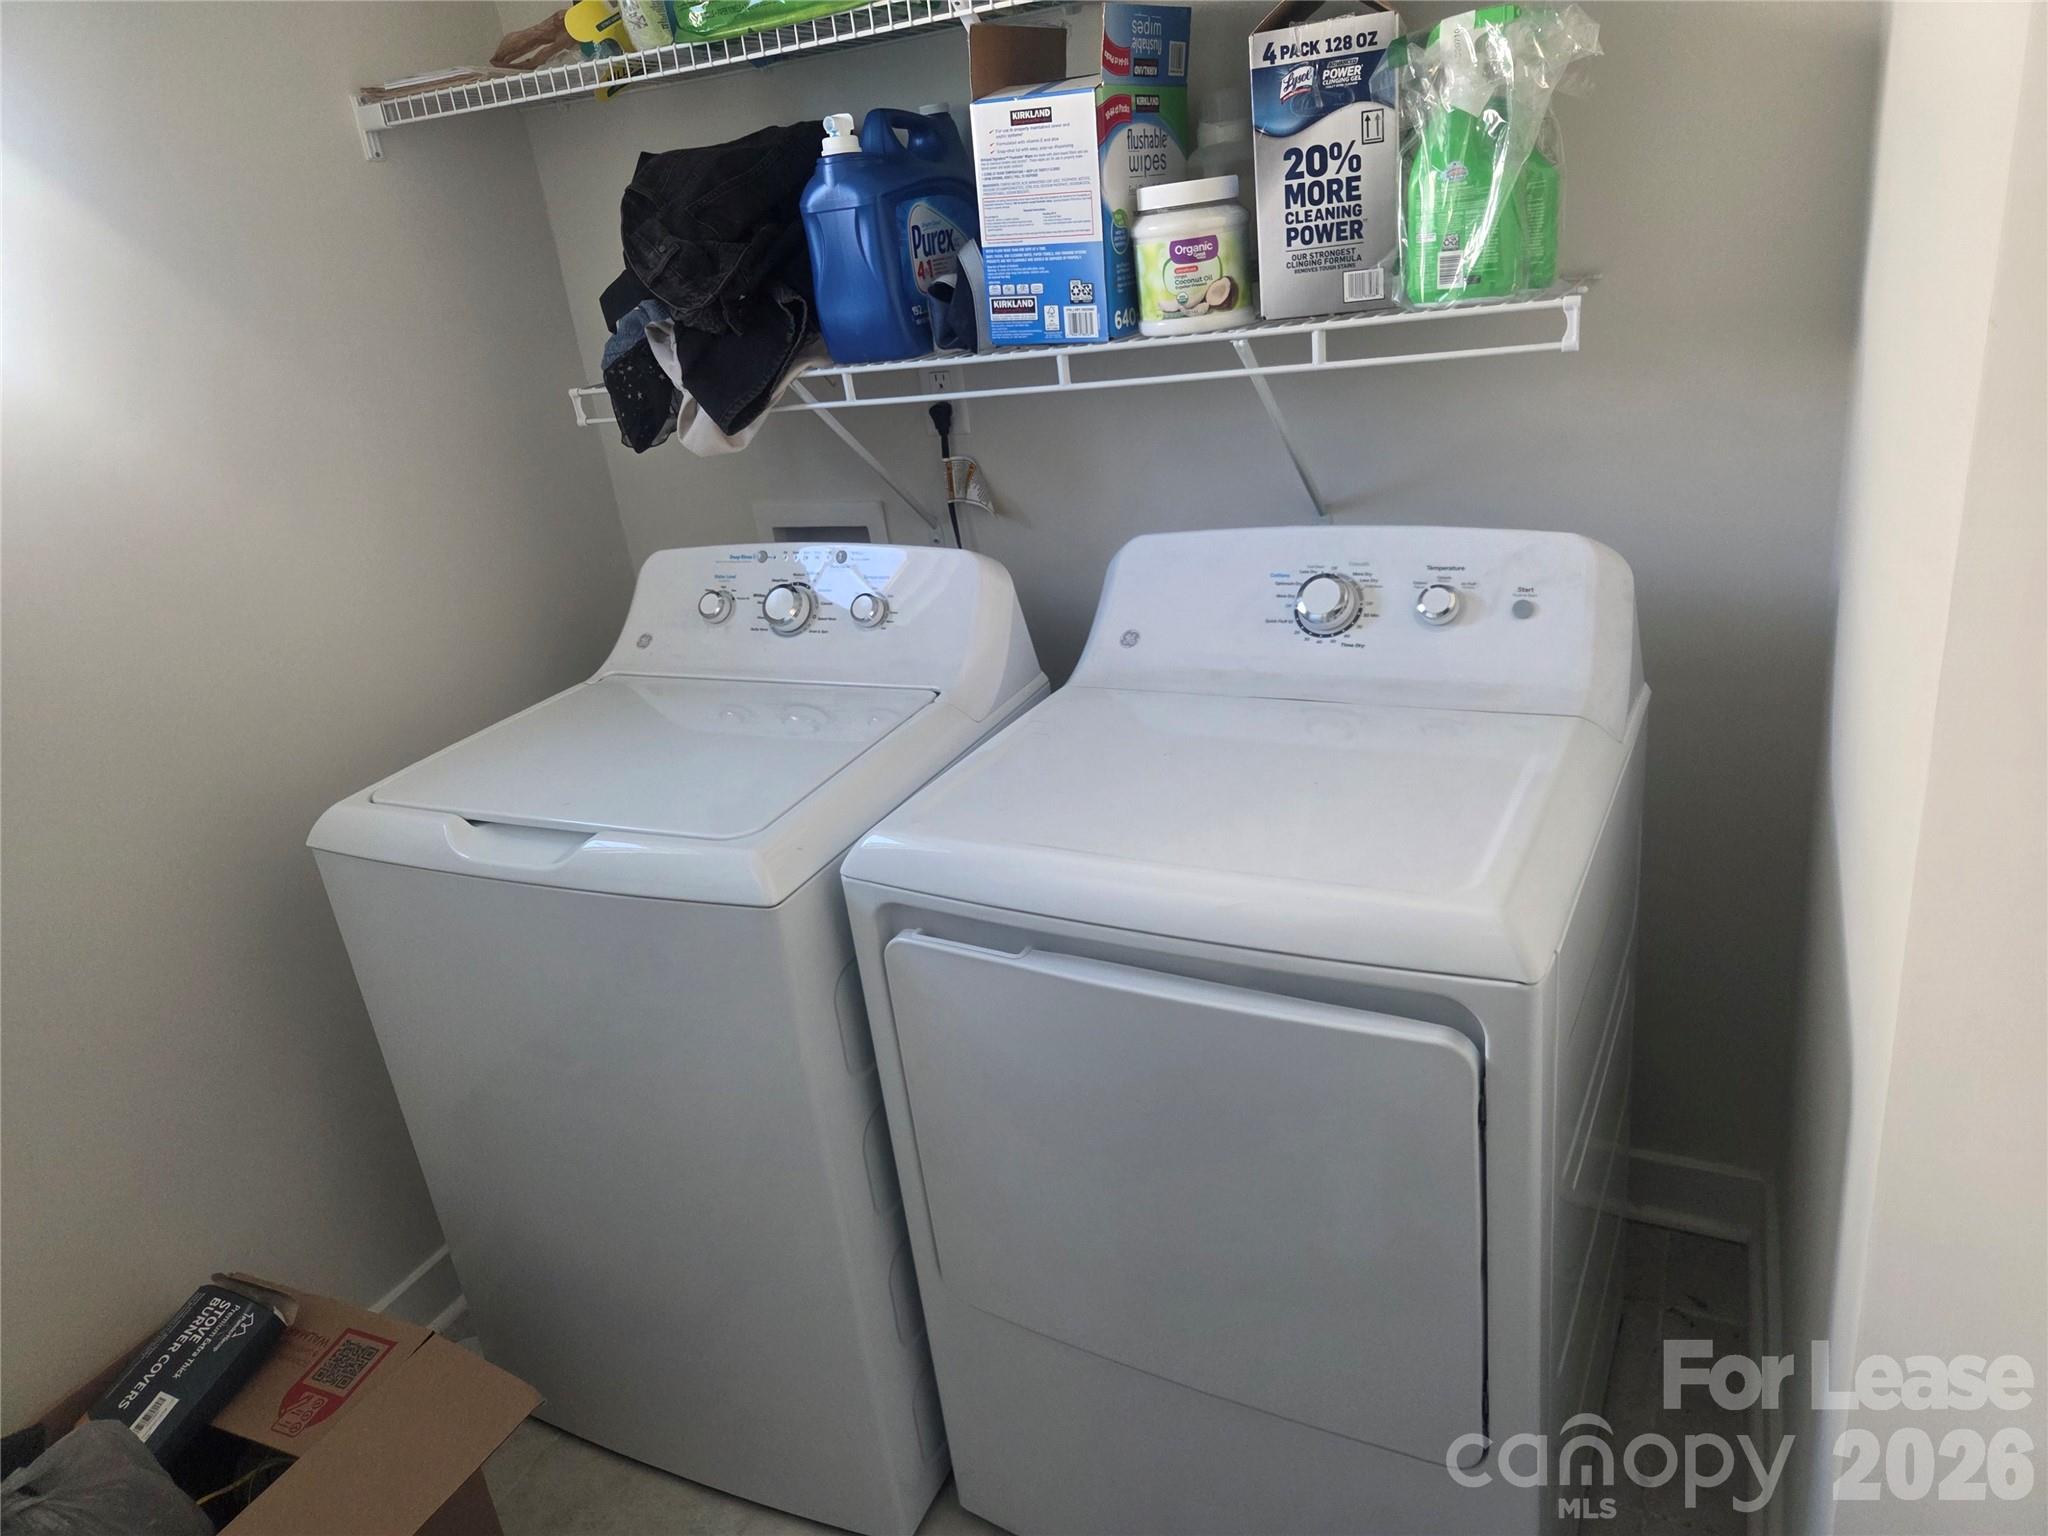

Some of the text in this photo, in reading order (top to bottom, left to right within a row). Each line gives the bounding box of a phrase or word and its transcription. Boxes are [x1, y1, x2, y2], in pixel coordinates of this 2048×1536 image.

[1131, 15, 1162, 34] wipes
[1131, 37, 1162, 55] flushable
[1263, 31, 1378, 65] 4 PACK 128 OZ
[1283, 69, 1313, 92] Lysol
[1322, 65, 1362, 80] POWER
[1322, 77, 1350, 86] CLINGING
[1136, 96, 1159, 106] KIRKLAND
[1012, 109, 1051, 120] KIRKLAND
[1127, 128, 1167, 150] flushable
[1128, 153, 1167, 178] wipes
[1283, 140, 1362, 181] 20%
[1285, 175, 1362, 209] MORE
[1285, 204, 1362, 225] CLEANING
[911, 225, 956, 259] Purex
[1286, 220, 1364, 247] POWER
[1174, 241, 1213, 257] Organic
[1291, 248, 1356, 261] OUR STRONGEST
[1286, 254, 1362, 269] CLINGING FORMULA
[1294, 266, 1319, 274] REMOVES
[1175, 277, 1203, 285] Coconut
[993, 300, 1034, 309] KIRKLAND
[1114, 308, 1136, 330] 640
[189, 1299, 232, 1345] STOVE
[210, 1304, 241, 1338] Premium
[117, 1297, 222, 1411] BURNER COVERS
[192, 1338, 212, 1358] Extra
[172, 1357, 195, 1380] Thick
